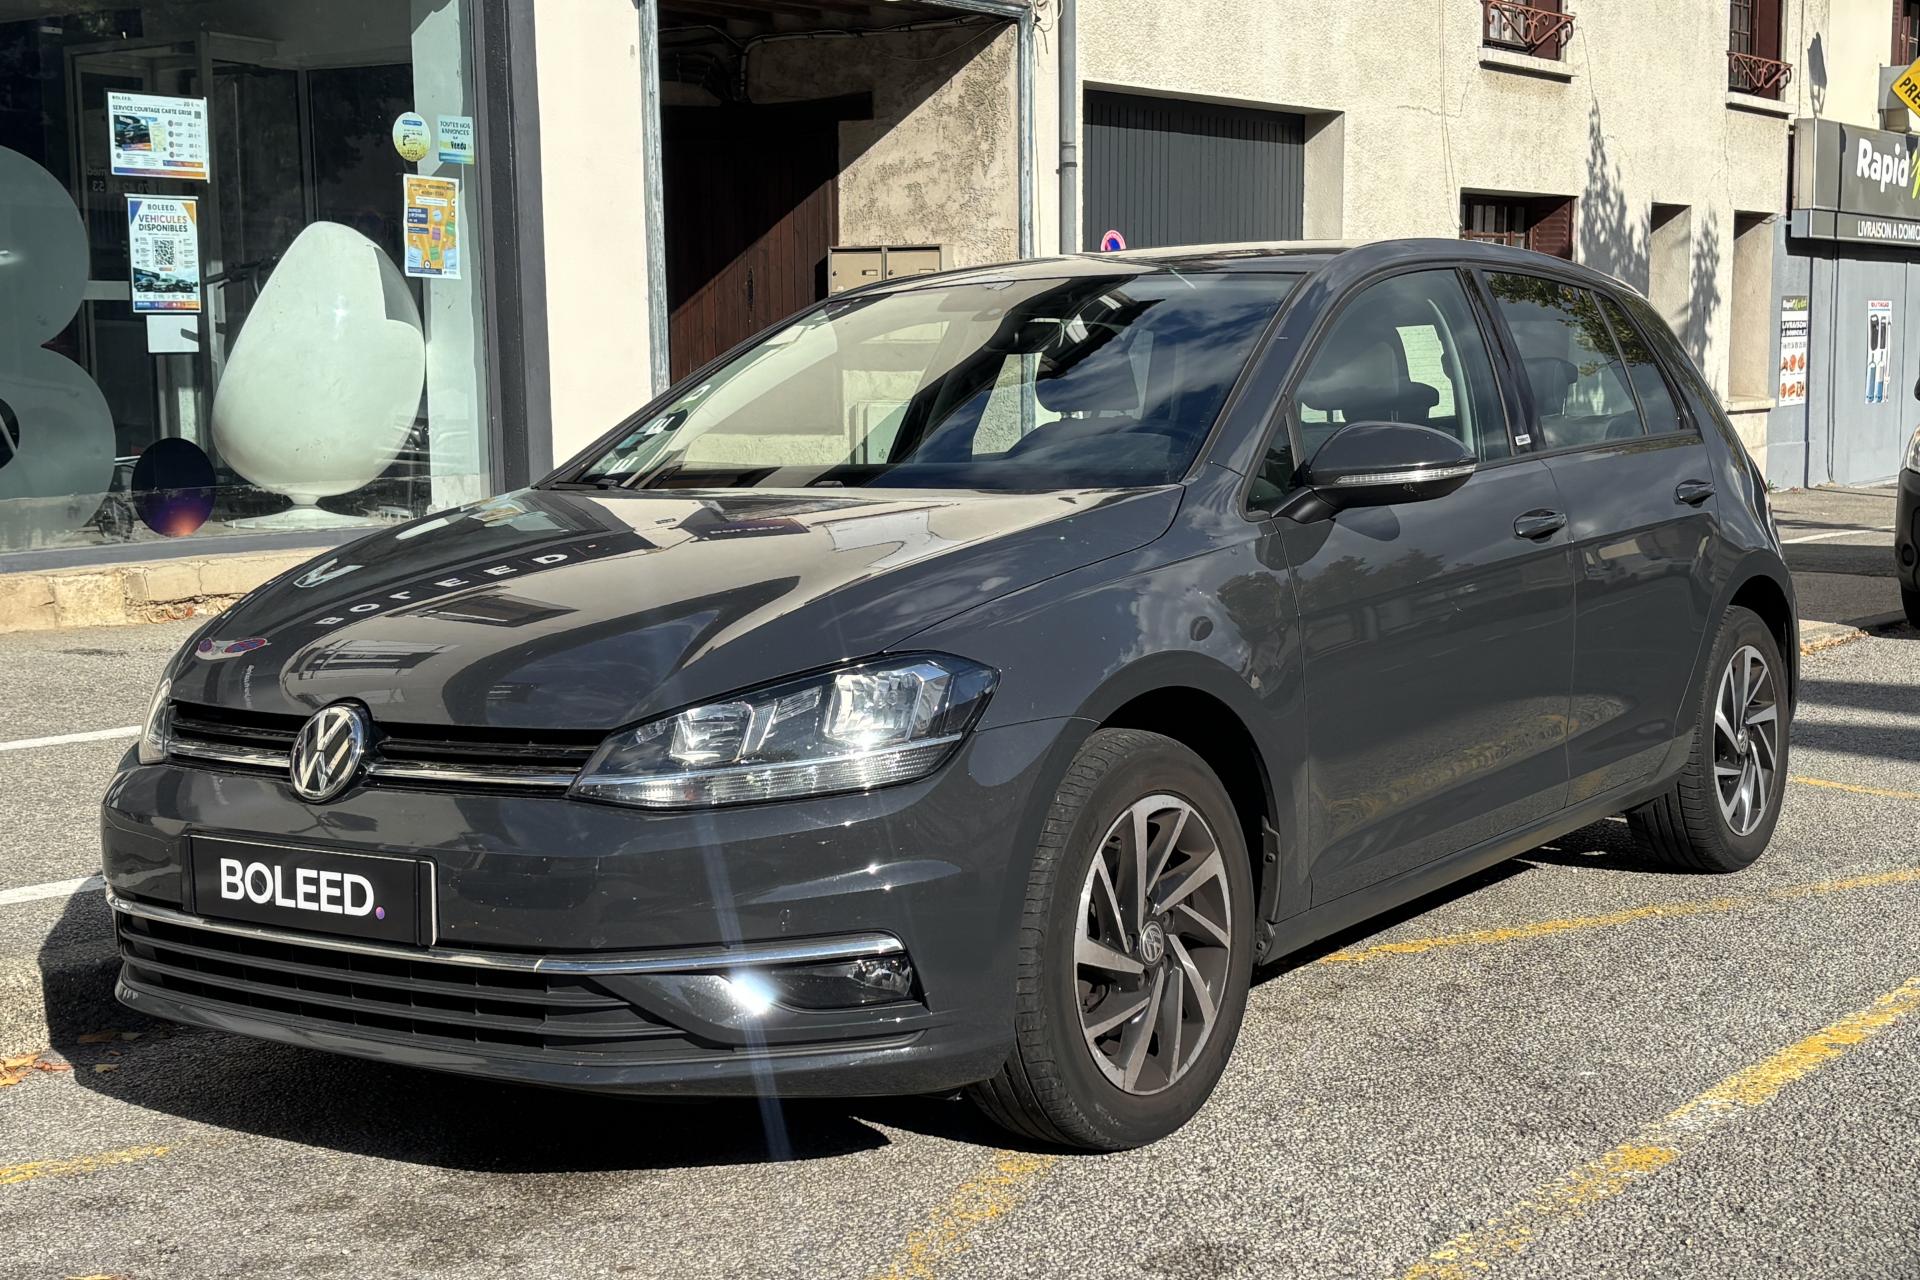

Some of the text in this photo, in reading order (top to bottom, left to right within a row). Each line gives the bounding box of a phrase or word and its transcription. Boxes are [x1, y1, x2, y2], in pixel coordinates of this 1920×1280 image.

[113, 104, 133, 112] SERVICE
[161, 107, 177, 115] CARTE
[440, 120, 459, 128] TOUTES
[441, 127, 470, 136] ANNONCES
[138, 214, 188, 224] VEHICULES
[138, 224, 188, 232] DISPONIBLES
[1858, 220, 1892, 239] LIVRAISON
